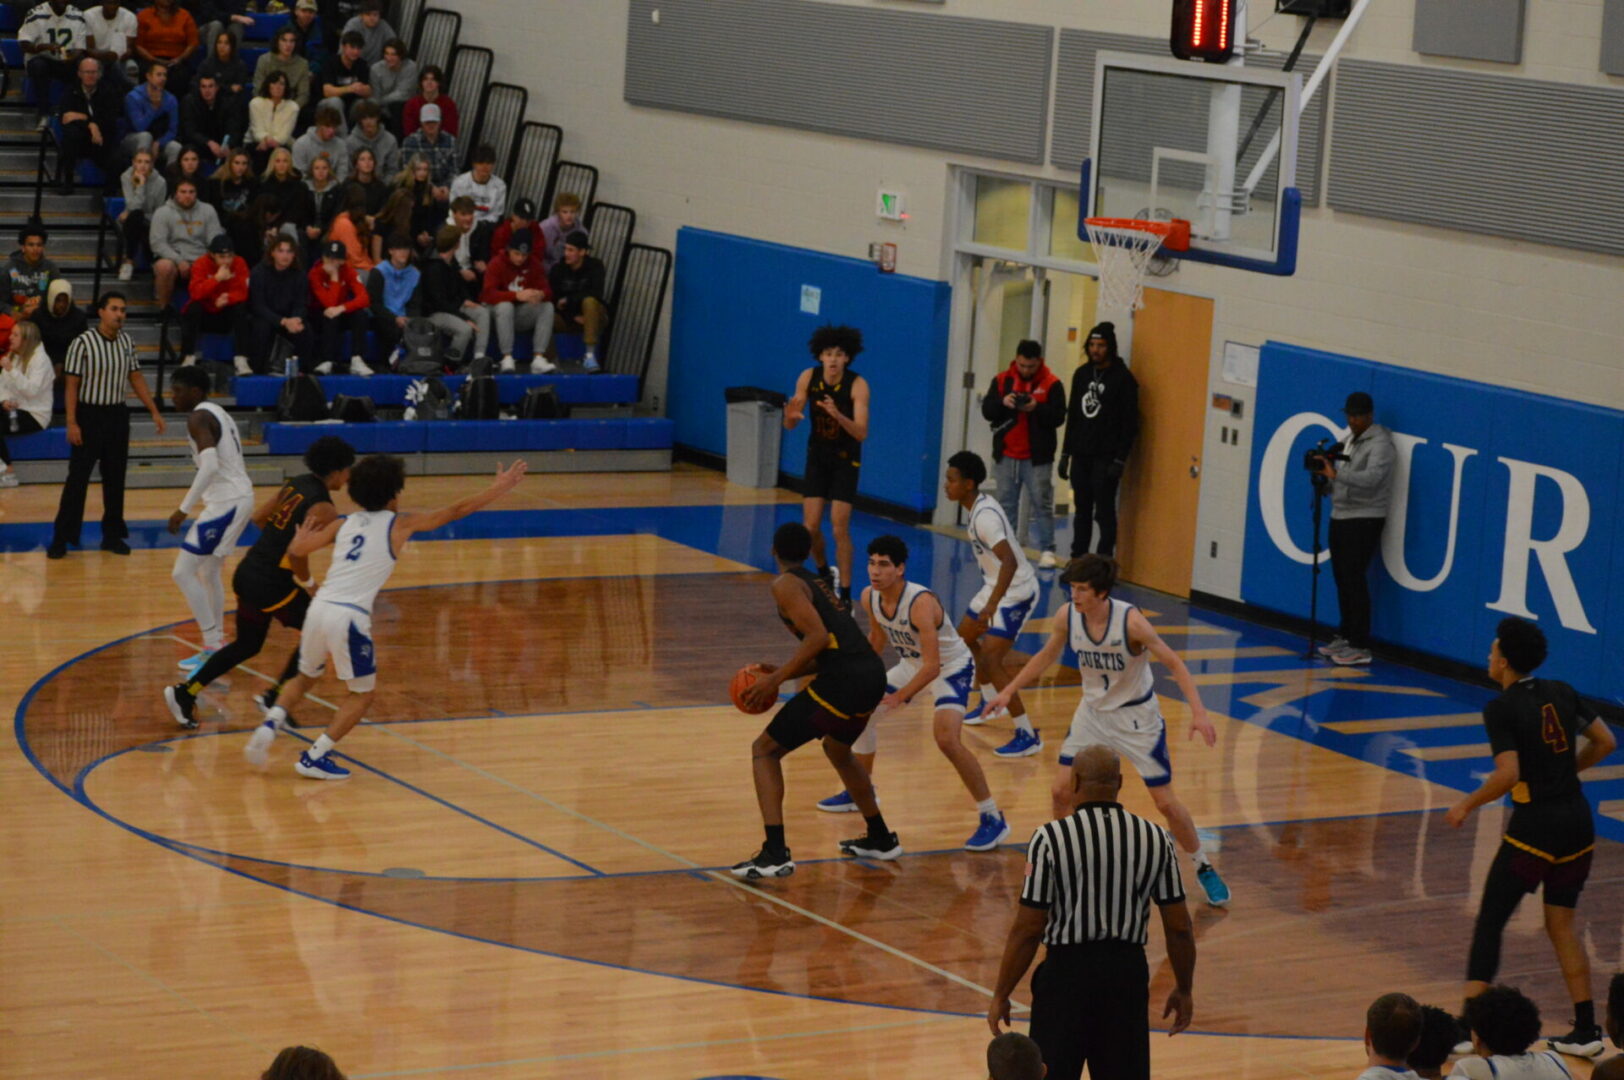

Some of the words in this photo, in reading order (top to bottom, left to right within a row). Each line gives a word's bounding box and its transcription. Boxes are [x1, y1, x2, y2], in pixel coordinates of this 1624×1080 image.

[47, 28, 73, 46] 12
[346, 535, 365, 561] 2
[1077, 649, 1125, 671] CURTIS
[1101, 674, 1109, 691] 1
[1541, 703, 1569, 753] 4
